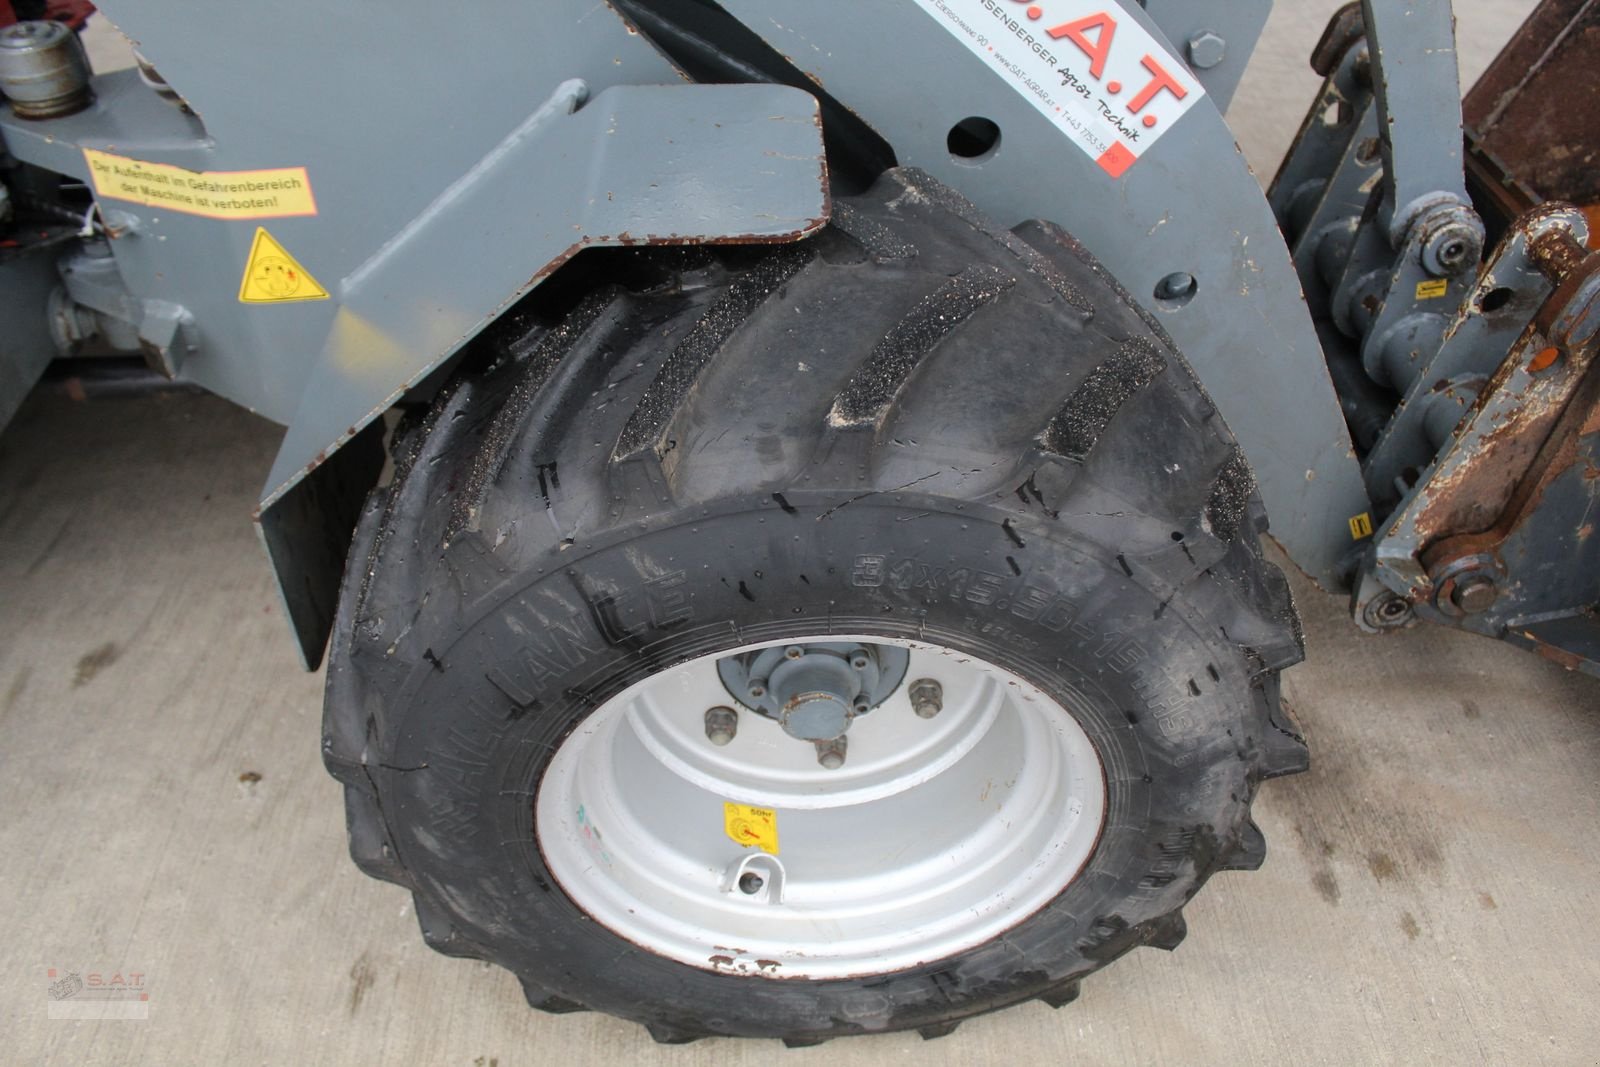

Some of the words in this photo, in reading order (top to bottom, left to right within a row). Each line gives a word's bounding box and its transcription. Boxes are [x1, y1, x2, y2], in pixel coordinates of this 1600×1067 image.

[980, 0, 1058, 67] SENBERGER
[1057, 67, 1092, 100] Agrar
[1098, 99, 1141, 143] Technik
[1008, 0, 1188, 128] .A.T.
[92, 160, 111, 173] Der
[113, 164, 170, 184] Aufenthalt
[171, 176, 186, 188] im
[189, 177, 302, 193] Gefahrenbereich
[120, 182, 138, 194] der
[140, 185, 192, 205] Maschine
[194, 195, 211, 208] ist
[212, 196, 278, 210] verboten!
